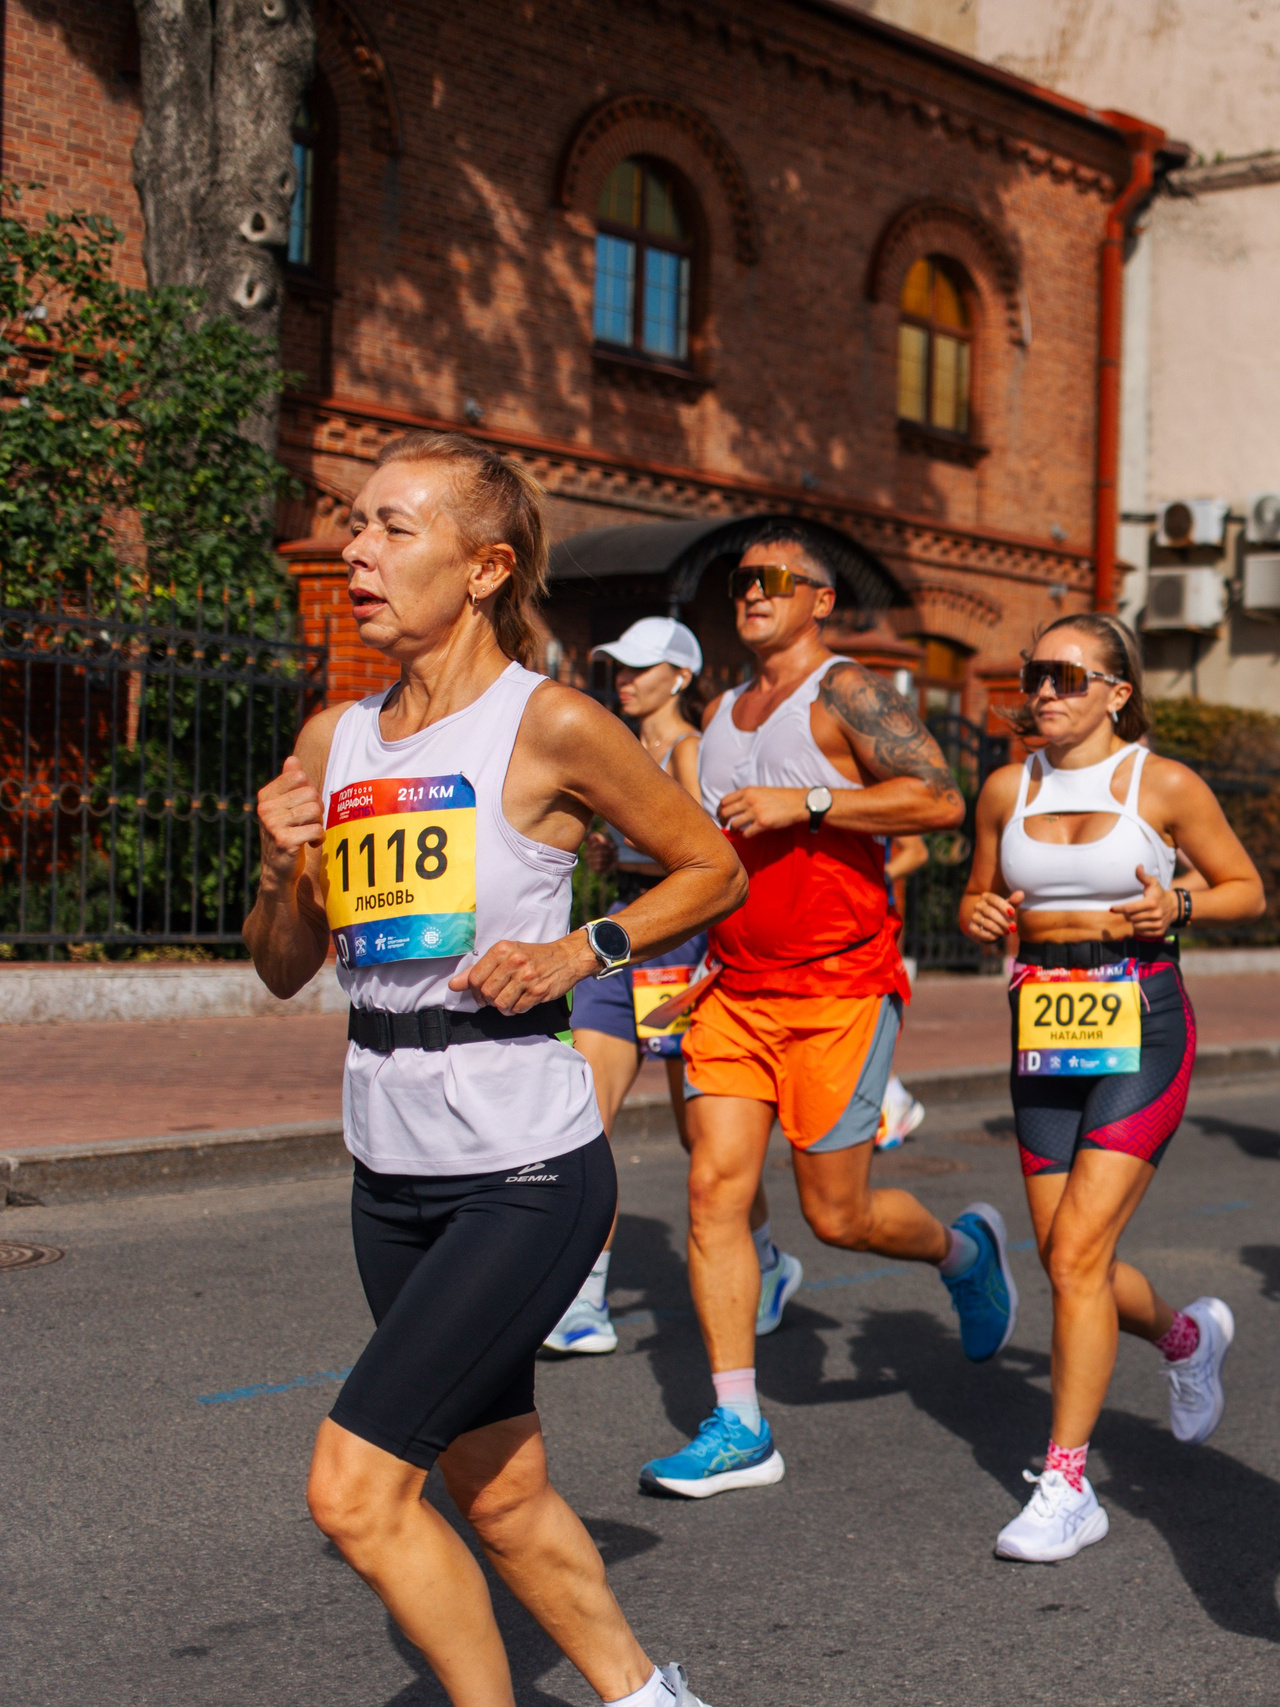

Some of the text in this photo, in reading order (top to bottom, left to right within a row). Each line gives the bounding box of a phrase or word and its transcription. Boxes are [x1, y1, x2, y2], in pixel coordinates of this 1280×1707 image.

[337, 795, 373, 812] МАРАФОН
[397, 787, 424, 802] 21,1
[336, 825, 448, 893] 1118
[354, 889, 415, 913] ЛЮБОВЬ
[337, 934, 349, 962] D
[1034, 993, 1122, 1027] 2029
[1050, 1031, 1103, 1040] НАТАЛИЯ
[1027, 1051, 1041, 1072] D
[505, 1174, 559, 1183] DEMIX
